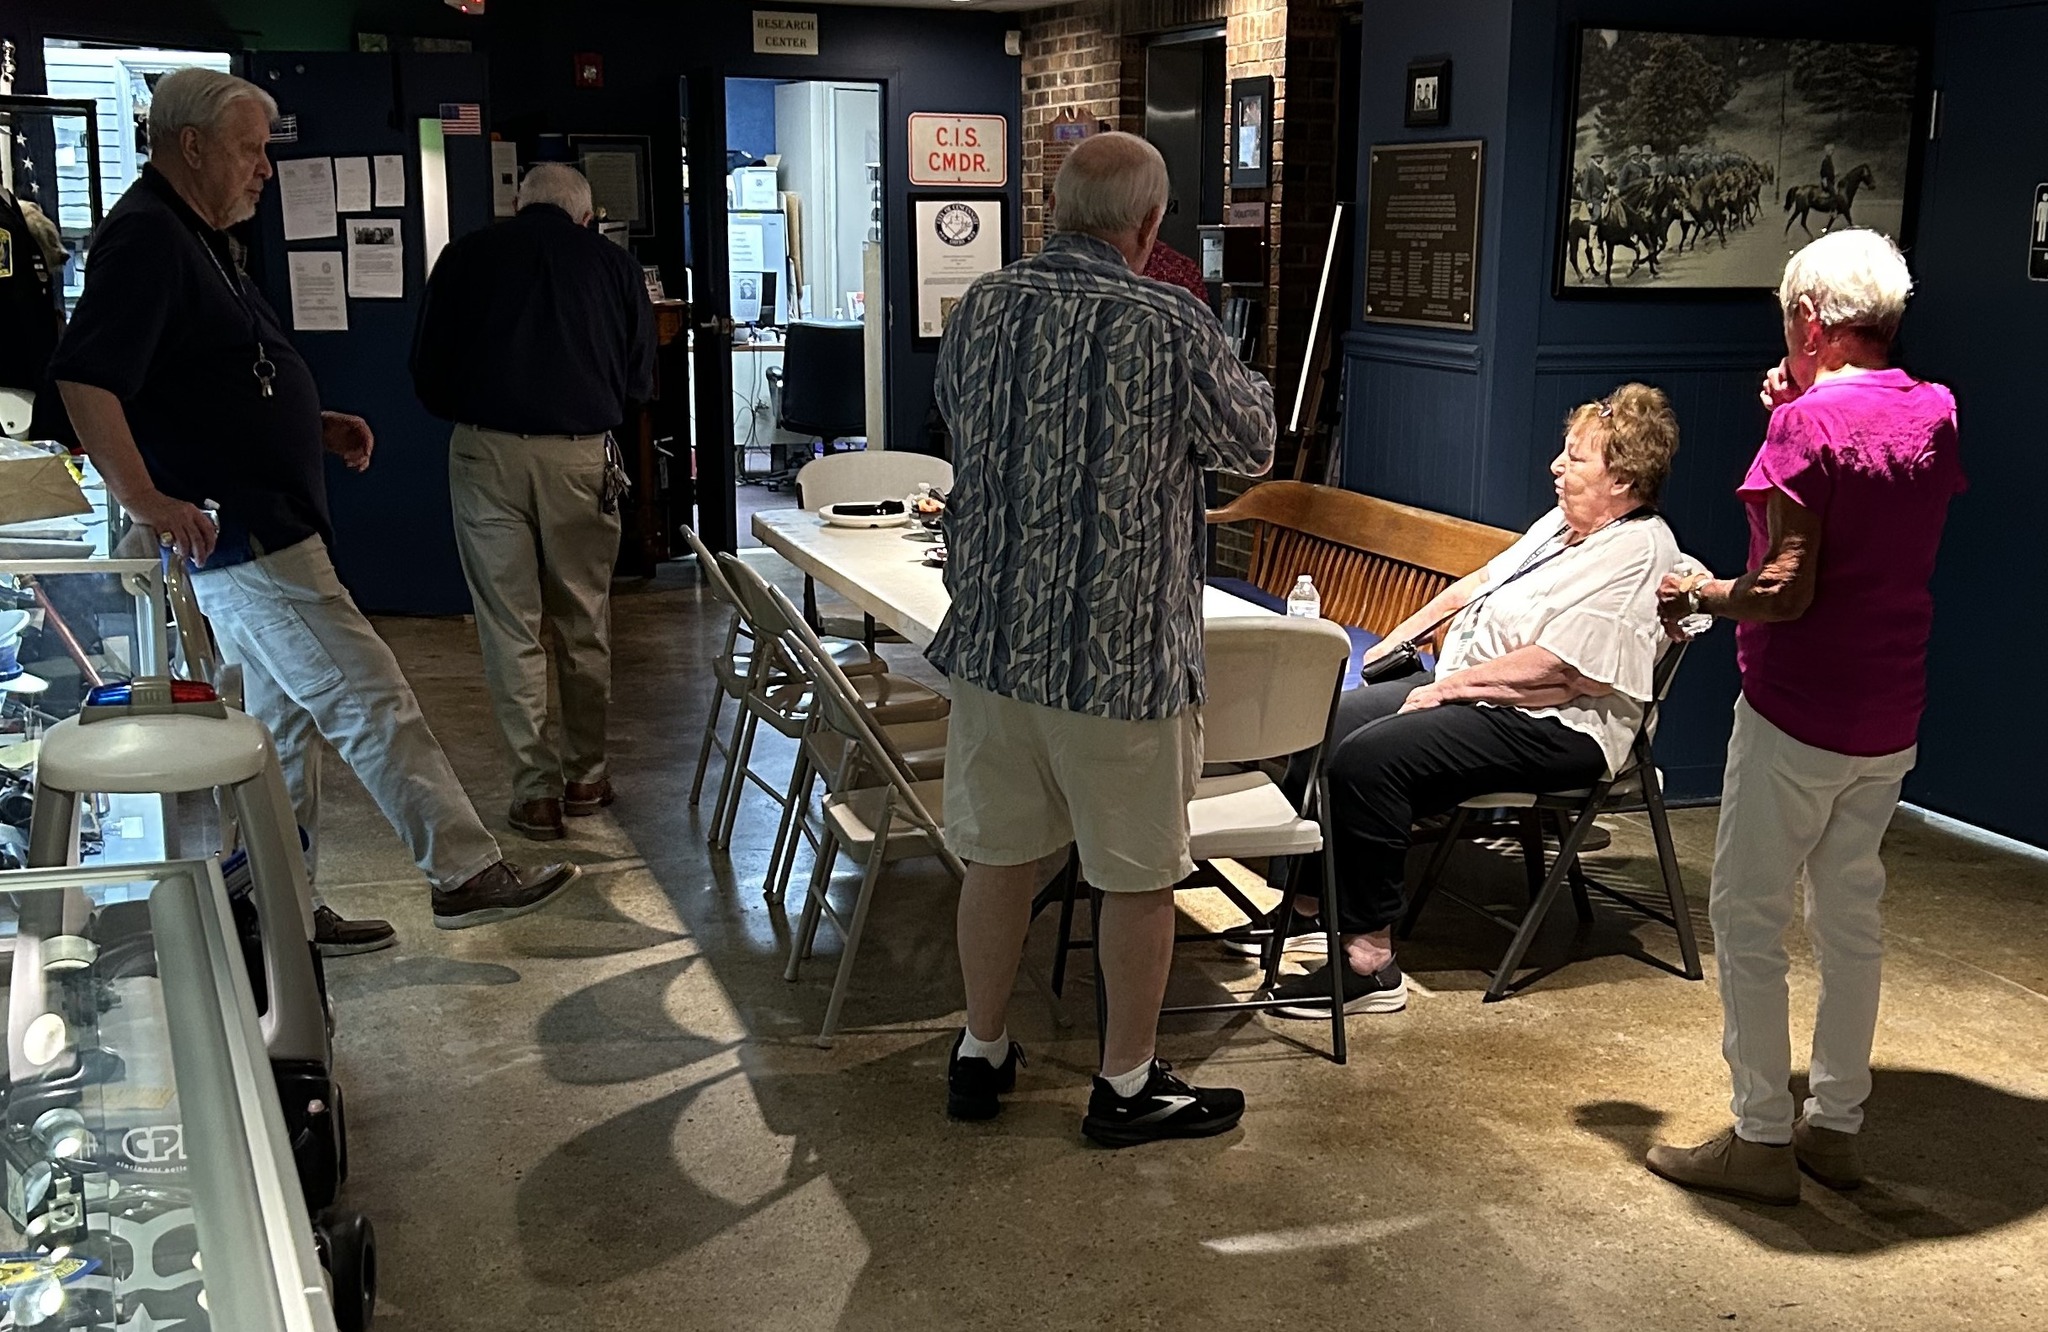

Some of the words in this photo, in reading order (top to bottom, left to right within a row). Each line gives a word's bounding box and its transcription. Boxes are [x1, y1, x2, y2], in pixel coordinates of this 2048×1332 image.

[757, 18, 814, 31] RESEARCH
[765, 36, 807, 49] CENTER
[936, 127, 981, 147] C.I.S.
[929, 152, 991, 172] CMDR.
